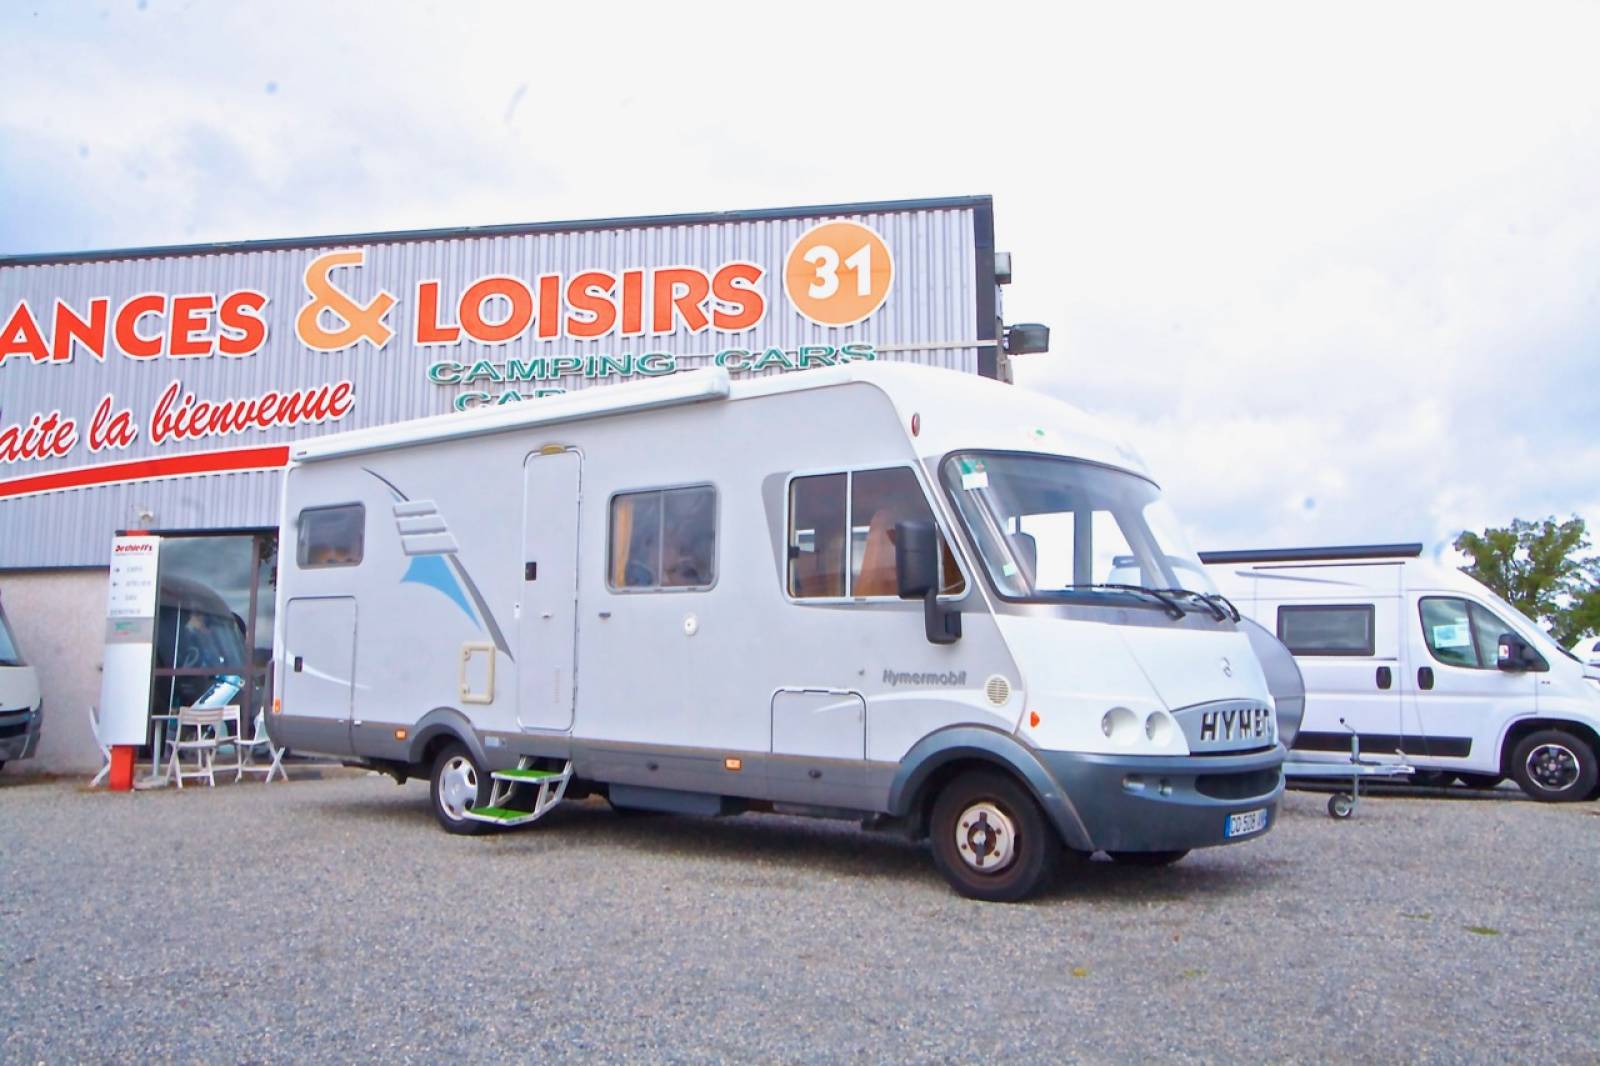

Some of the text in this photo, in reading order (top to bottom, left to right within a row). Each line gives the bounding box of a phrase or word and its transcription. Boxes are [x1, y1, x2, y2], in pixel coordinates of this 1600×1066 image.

[298, 252, 397, 351] &
[416, 263, 765, 344] LOISIRS
[803, 244, 872, 299] 31
[428, 344, 876, 384] CAMPING CARS
[90, 396, 136, 450] la
[152, 382, 351, 443] bienvenue
[882, 668, 967, 687] Hymermobil
